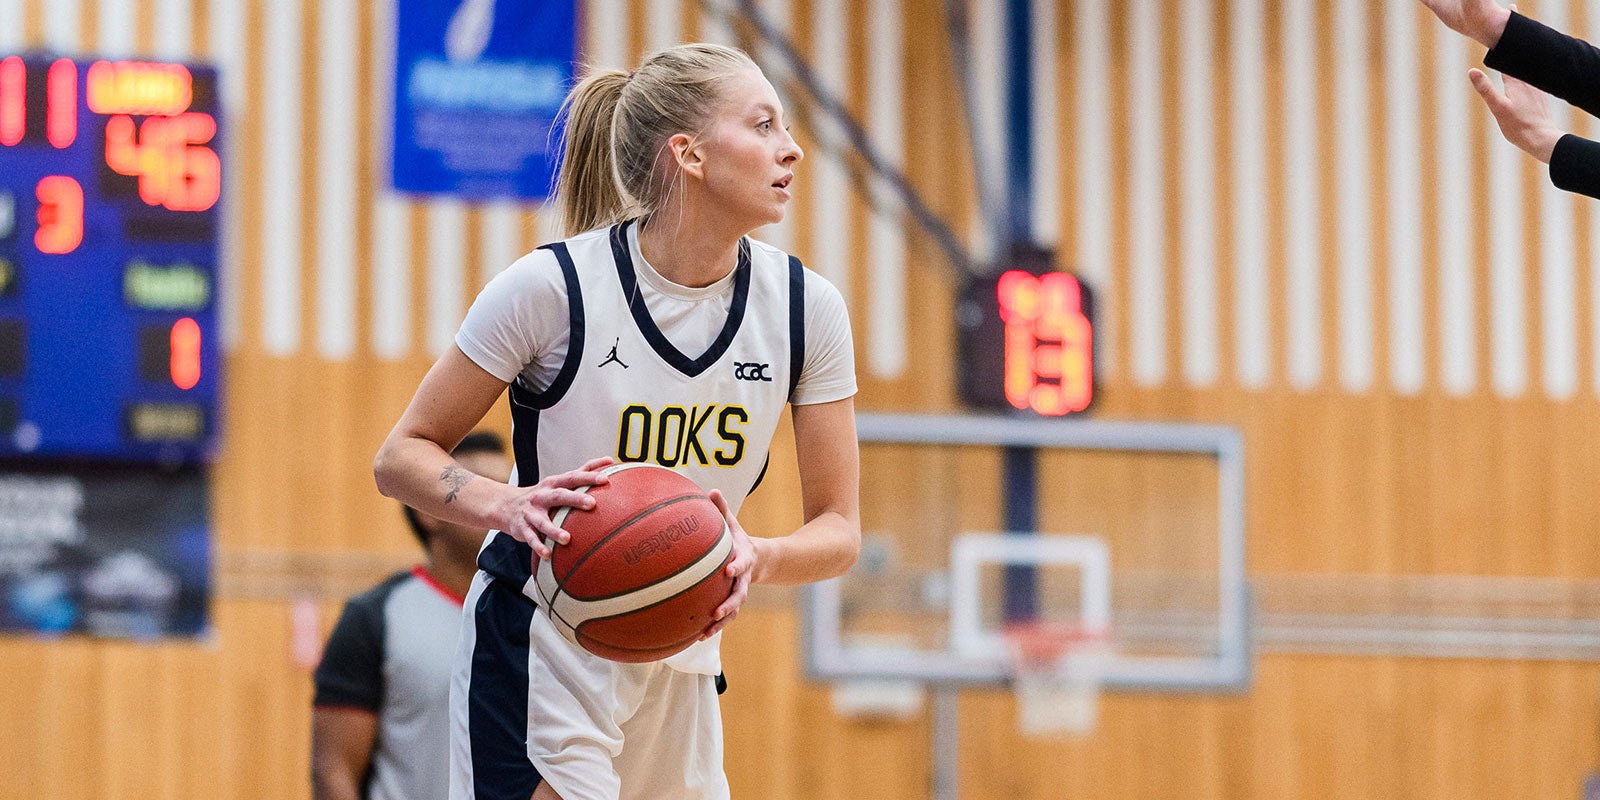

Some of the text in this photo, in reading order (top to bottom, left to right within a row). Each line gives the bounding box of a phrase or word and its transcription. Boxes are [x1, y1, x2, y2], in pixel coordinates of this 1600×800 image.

[35, 175, 84, 254] 3
[615, 403, 750, 469] OOKS
[623, 514, 700, 565] molten
